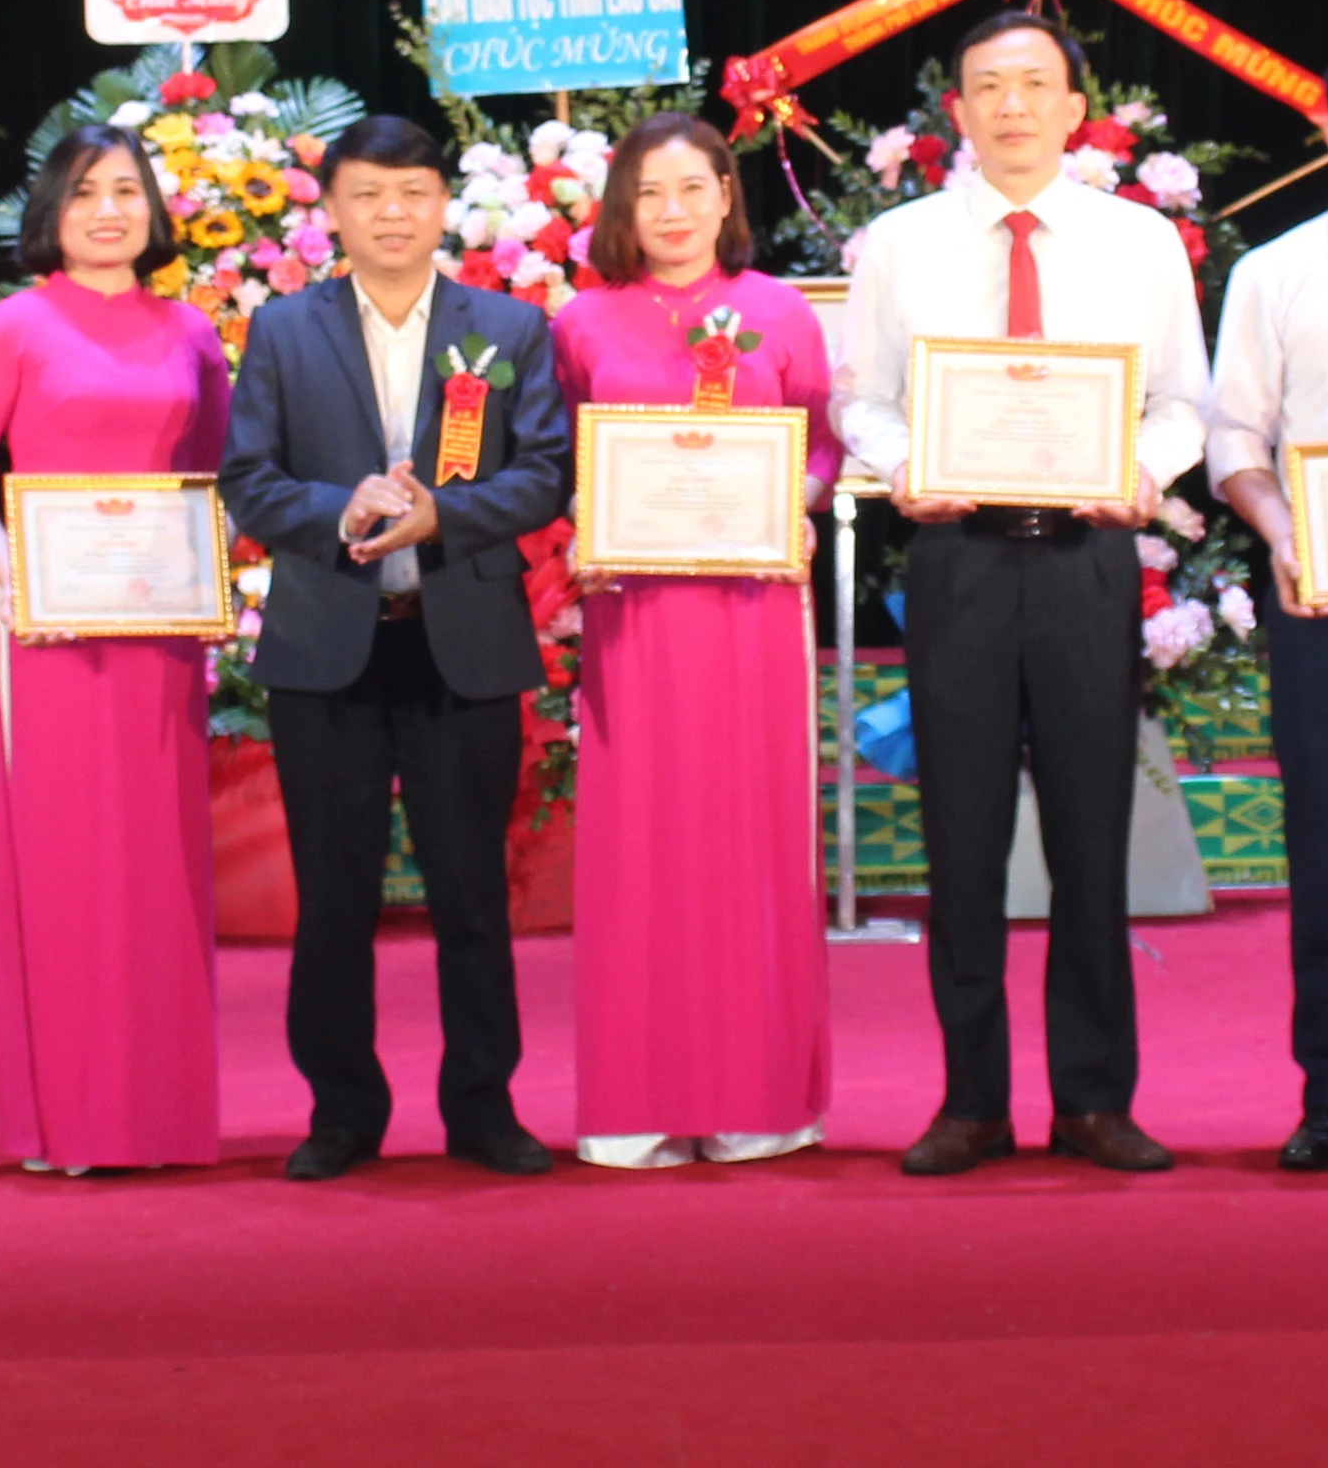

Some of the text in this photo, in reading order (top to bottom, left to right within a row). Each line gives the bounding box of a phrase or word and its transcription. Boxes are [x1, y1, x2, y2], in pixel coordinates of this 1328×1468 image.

[443, 20, 670, 76] CHÚC MỪNG
[1211, 32, 1323, 107] MỪNG
